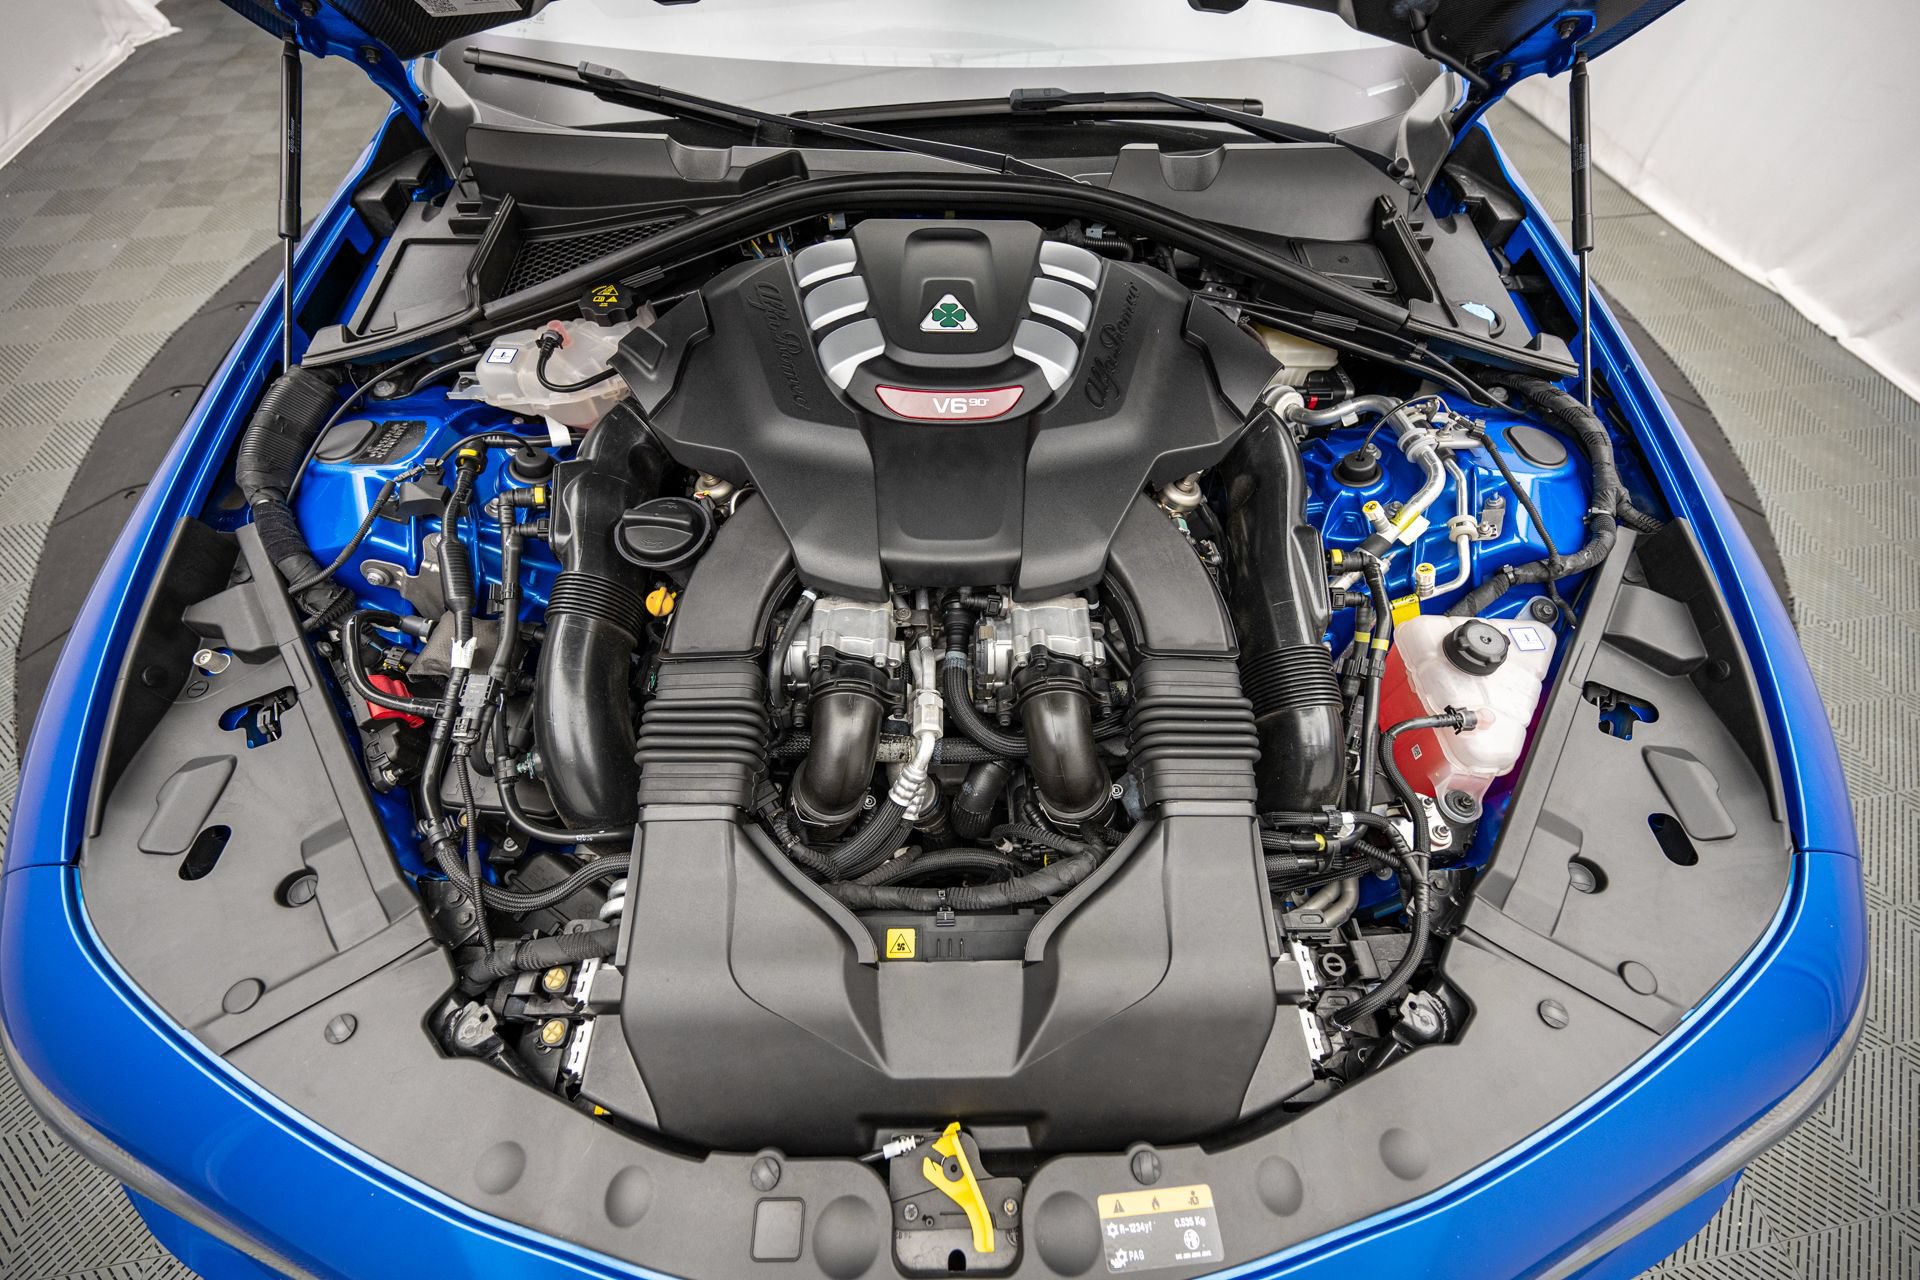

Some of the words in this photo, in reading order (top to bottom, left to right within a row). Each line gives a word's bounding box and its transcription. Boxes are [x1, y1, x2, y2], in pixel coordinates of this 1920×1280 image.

[746, 280, 789, 331] Alfa
[774, 330, 811, 410] Romeo
[1100, 281, 1139, 349] Romeo
[932, 397, 968, 414] V6
[1085, 349, 1121, 409] Alfa
